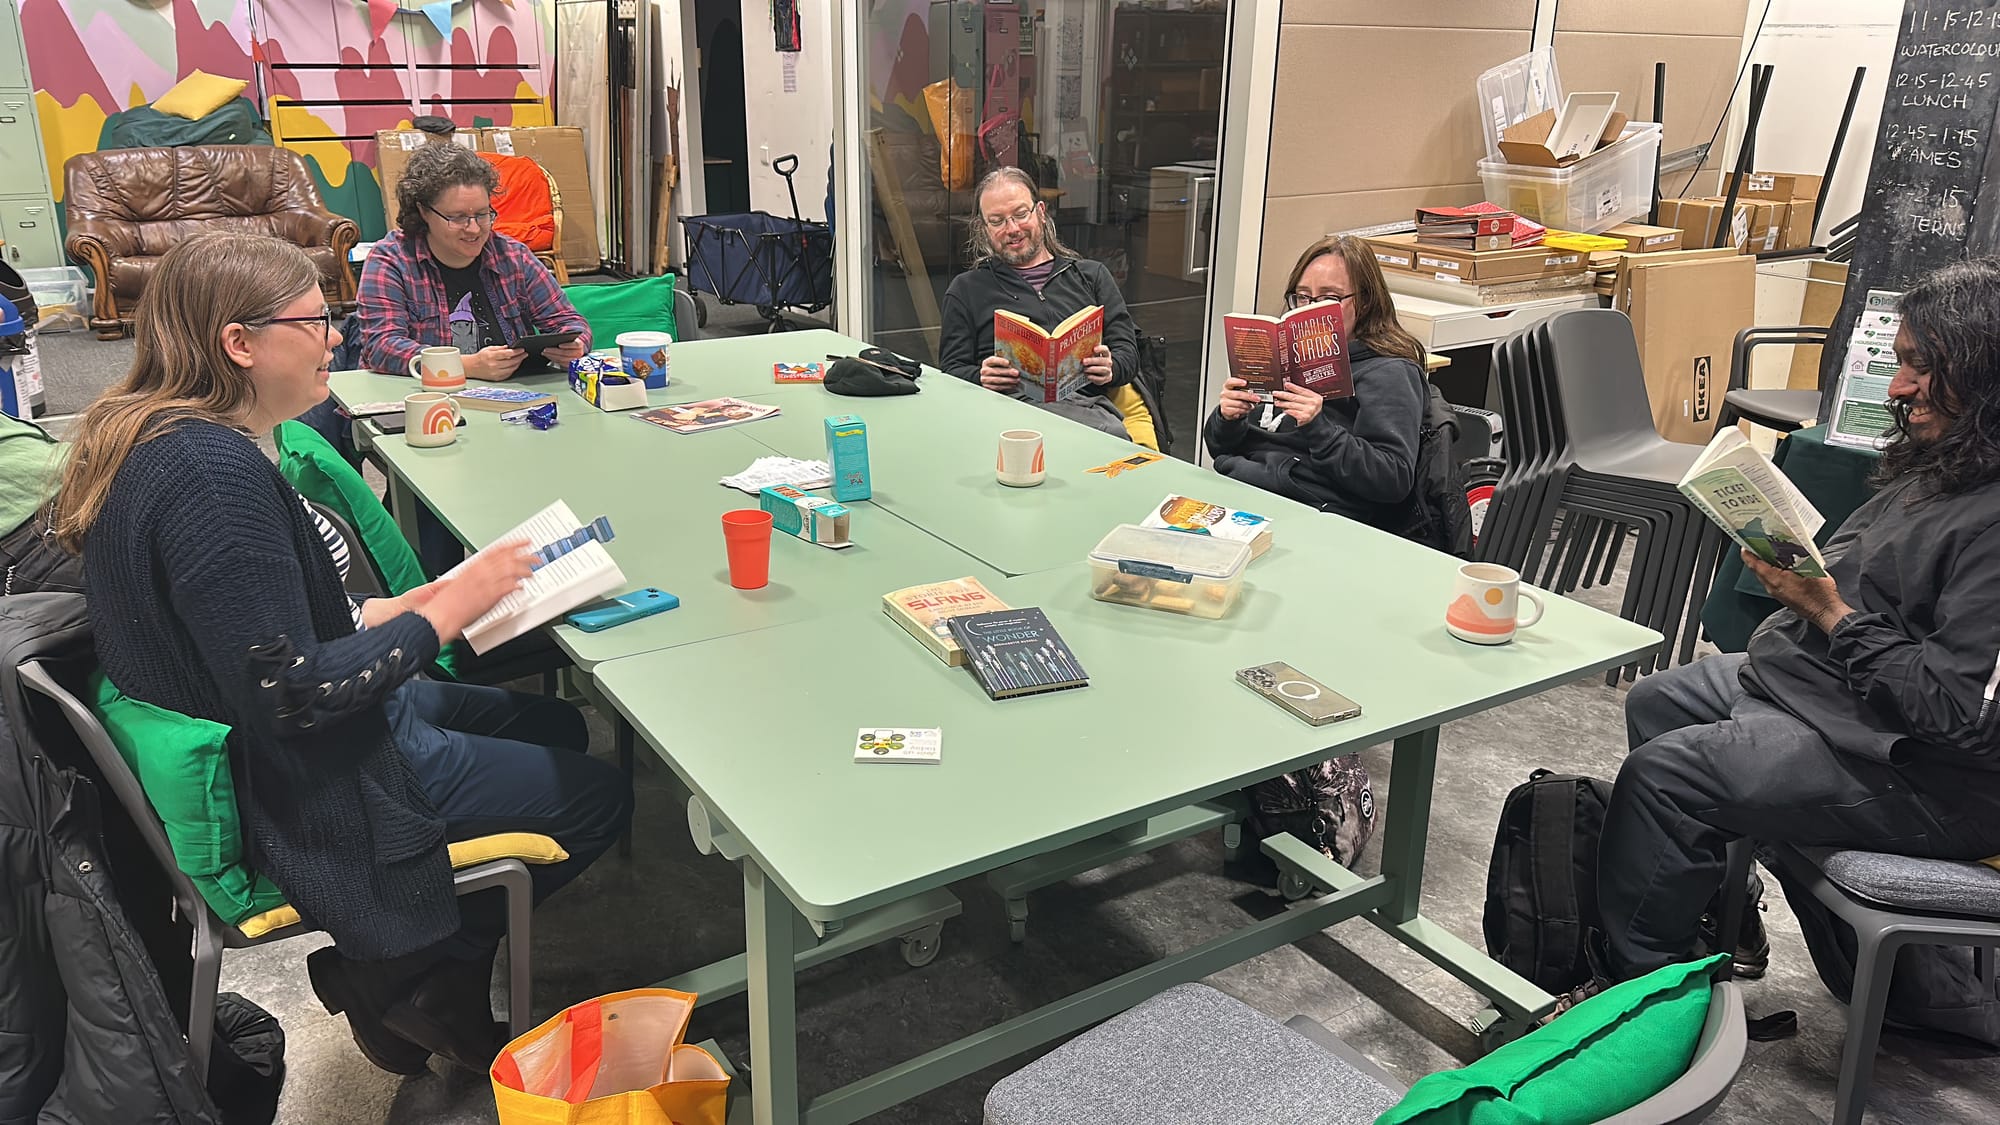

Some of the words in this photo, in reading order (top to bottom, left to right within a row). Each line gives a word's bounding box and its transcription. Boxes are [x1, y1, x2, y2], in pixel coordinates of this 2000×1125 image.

[1902, 93, 1967, 110] LUNCH
[1060, 315, 1102, 353] PRATCHETT
[1290, 313, 1335, 341] CHARLES
[1292, 332, 1341, 365] STROSS
[1697, 362, 1706, 416] IKEA
[1713, 483, 1749, 499] TICKET
[1721, 498, 1739, 510] TO
[1738, 494, 1761, 507] RIDE
[907, 591, 986, 611] SLANG
[982, 630, 1040, 643] WONDER
